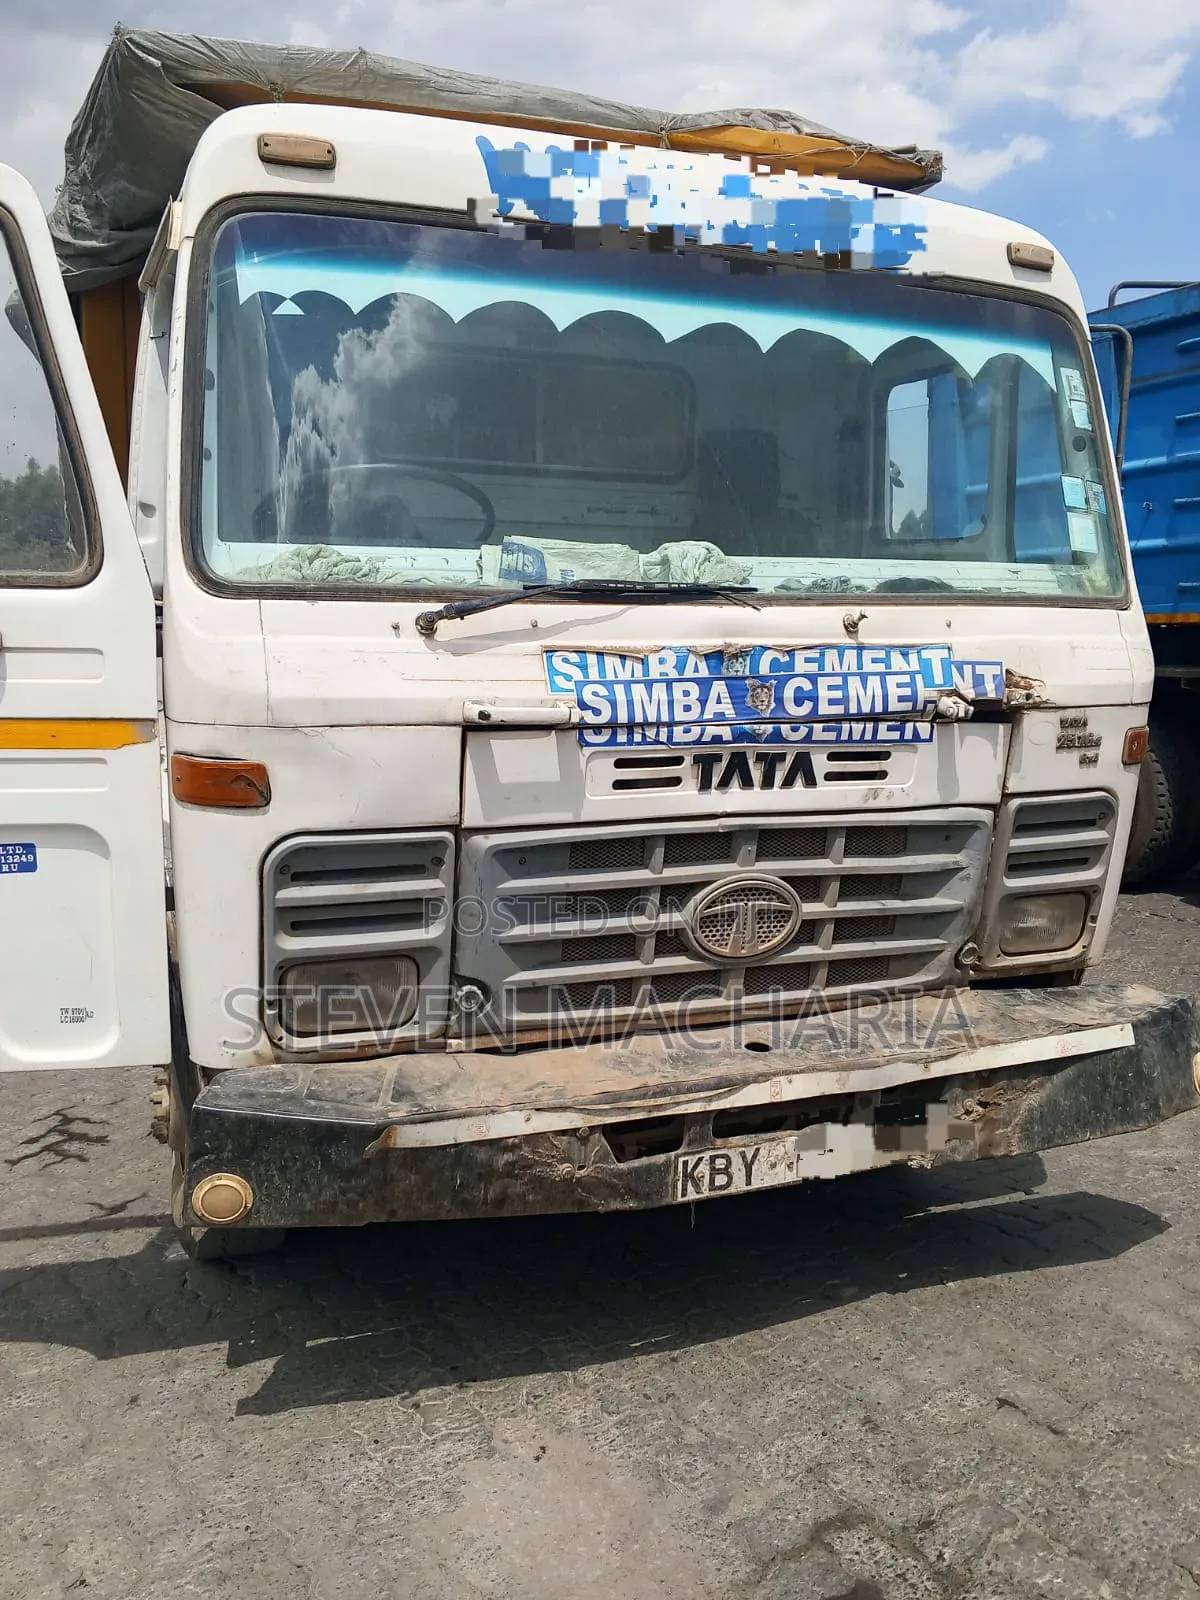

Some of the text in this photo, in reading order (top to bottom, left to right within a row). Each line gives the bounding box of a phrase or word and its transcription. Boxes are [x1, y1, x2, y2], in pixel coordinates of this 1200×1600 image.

[581, 681, 736, 724] SIMBA
[692, 751, 817, 790] TATA
[0, 846, 26, 855] LTD.
[0, 854, 34, 863] 13249
[680, 1147, 760, 1198] KBY
